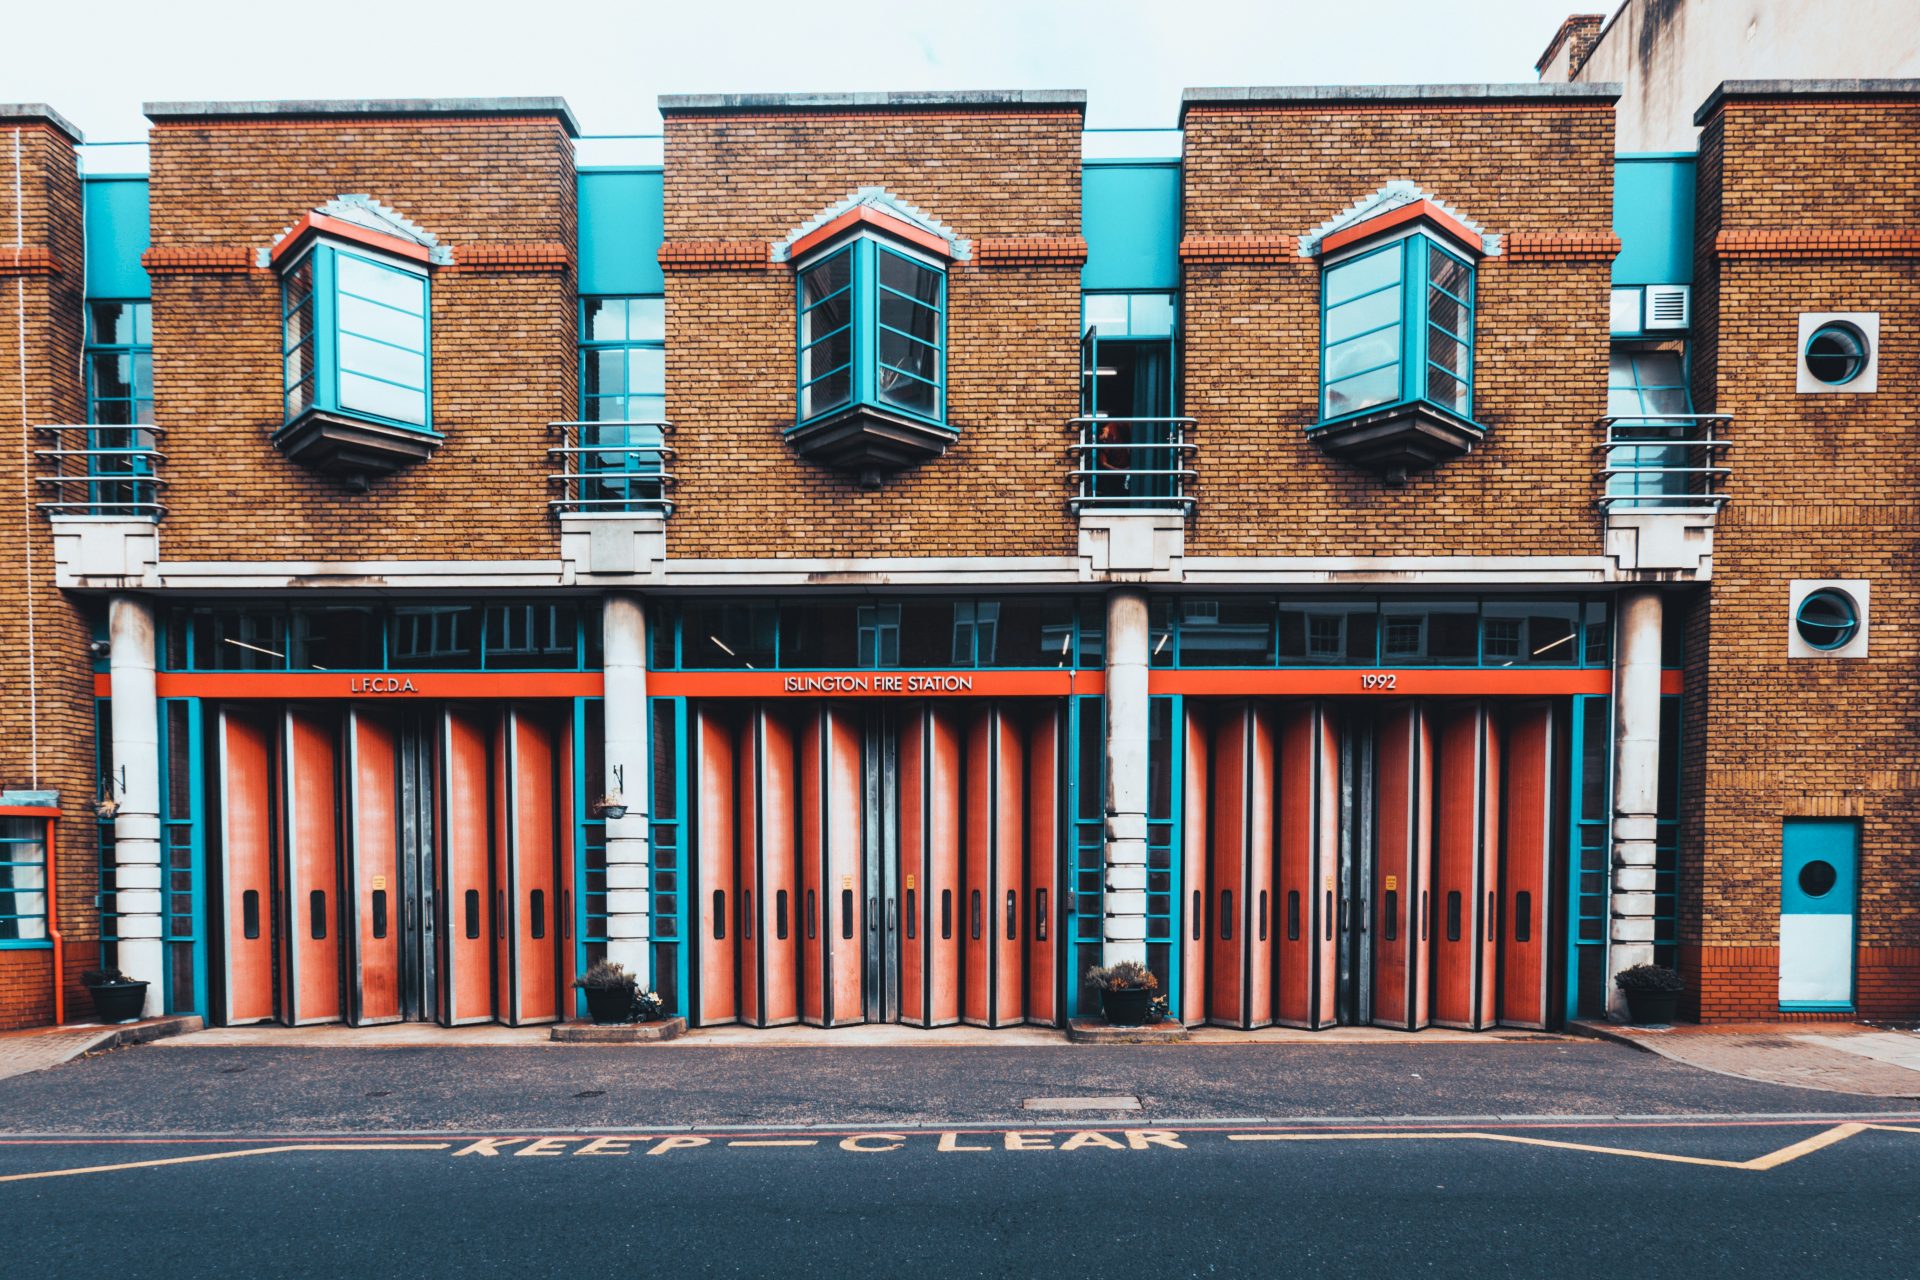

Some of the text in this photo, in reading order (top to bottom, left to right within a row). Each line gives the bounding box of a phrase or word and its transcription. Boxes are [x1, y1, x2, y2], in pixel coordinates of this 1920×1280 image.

[784, 675, 972, 691] ISLINGTON FIRE STATION
[1361, 674, 1396, 689] 1992
[451, 1131, 1187, 1156] KEEP CLEAR
